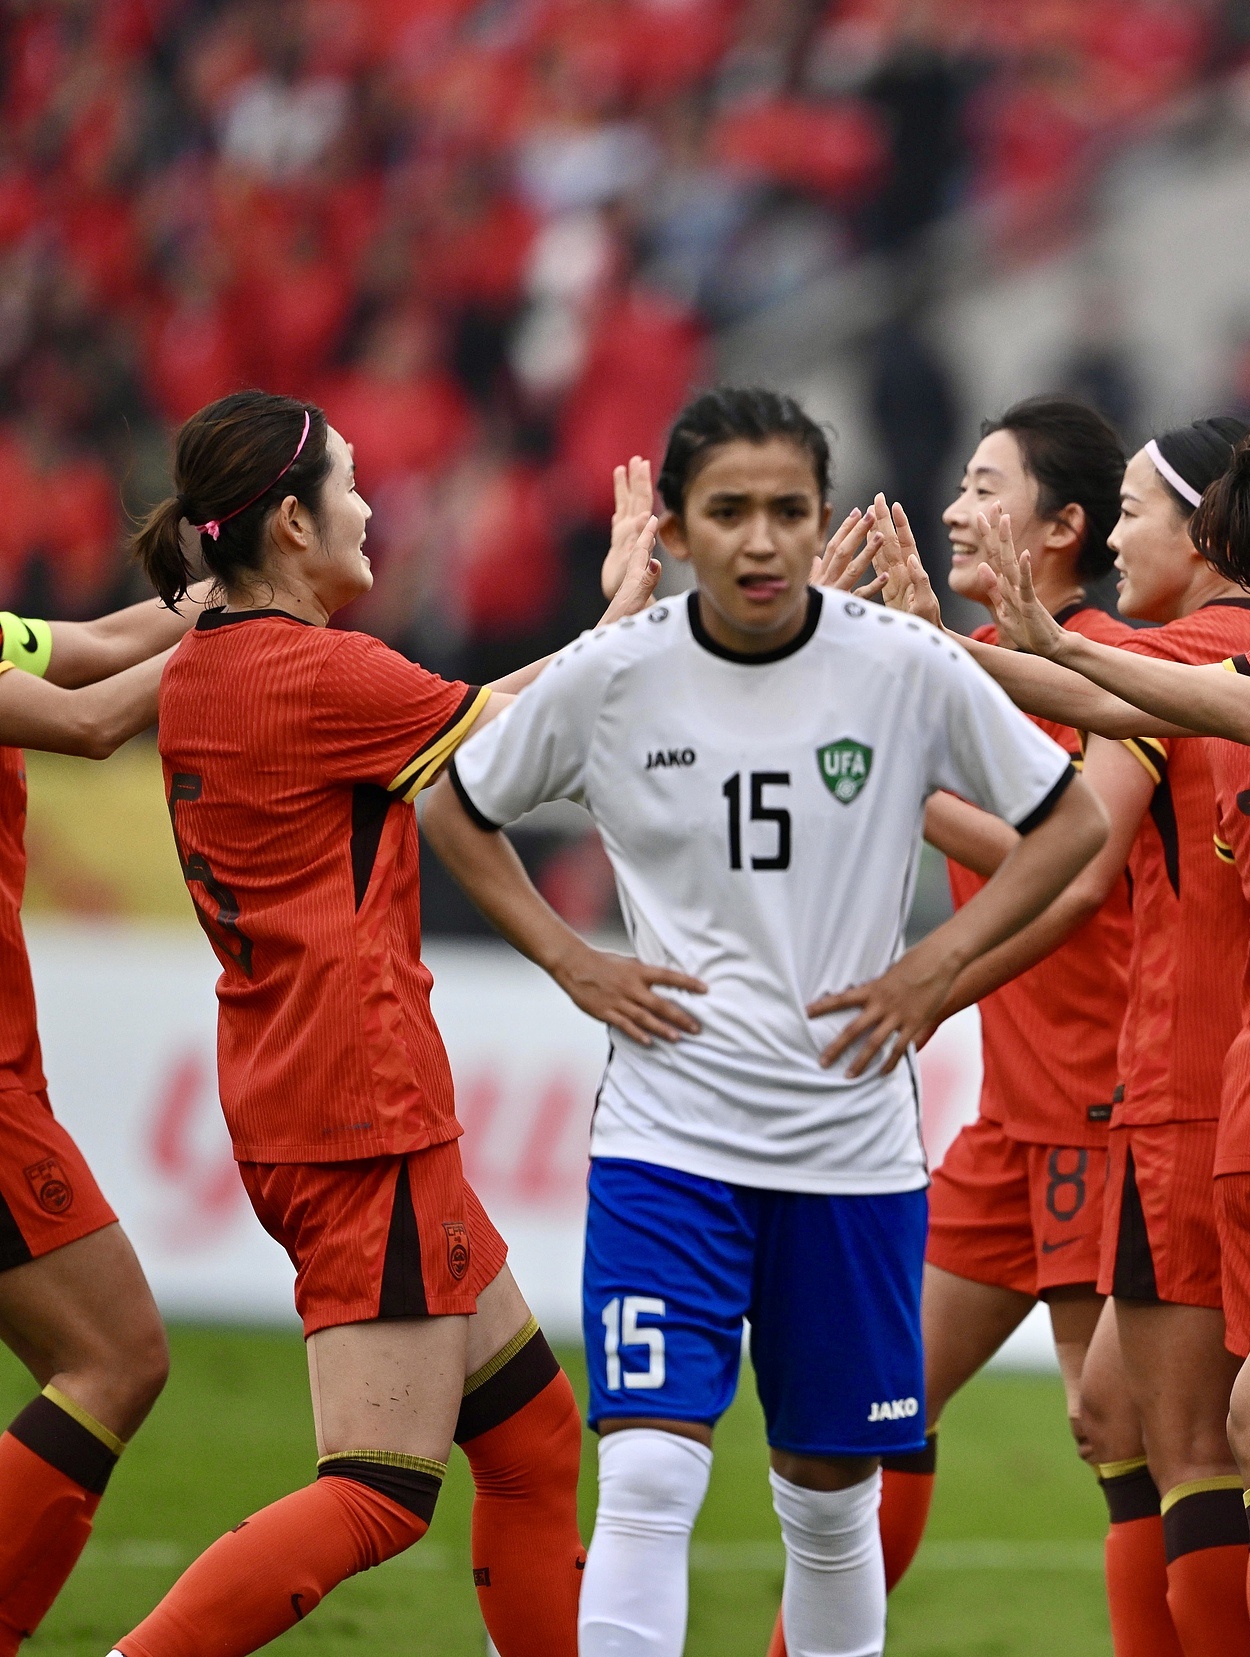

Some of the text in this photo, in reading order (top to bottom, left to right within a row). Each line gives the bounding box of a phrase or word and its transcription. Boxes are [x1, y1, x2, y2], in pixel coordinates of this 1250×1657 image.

[646, 748, 696, 770] JAKO
[823, 751, 866, 776] UFA
[723, 771, 791, 872] 15
[1046, 1147, 1088, 1222] 8
[601, 1296, 666, 1391] 15
[868, 1397, 919, 1423] JAKO
